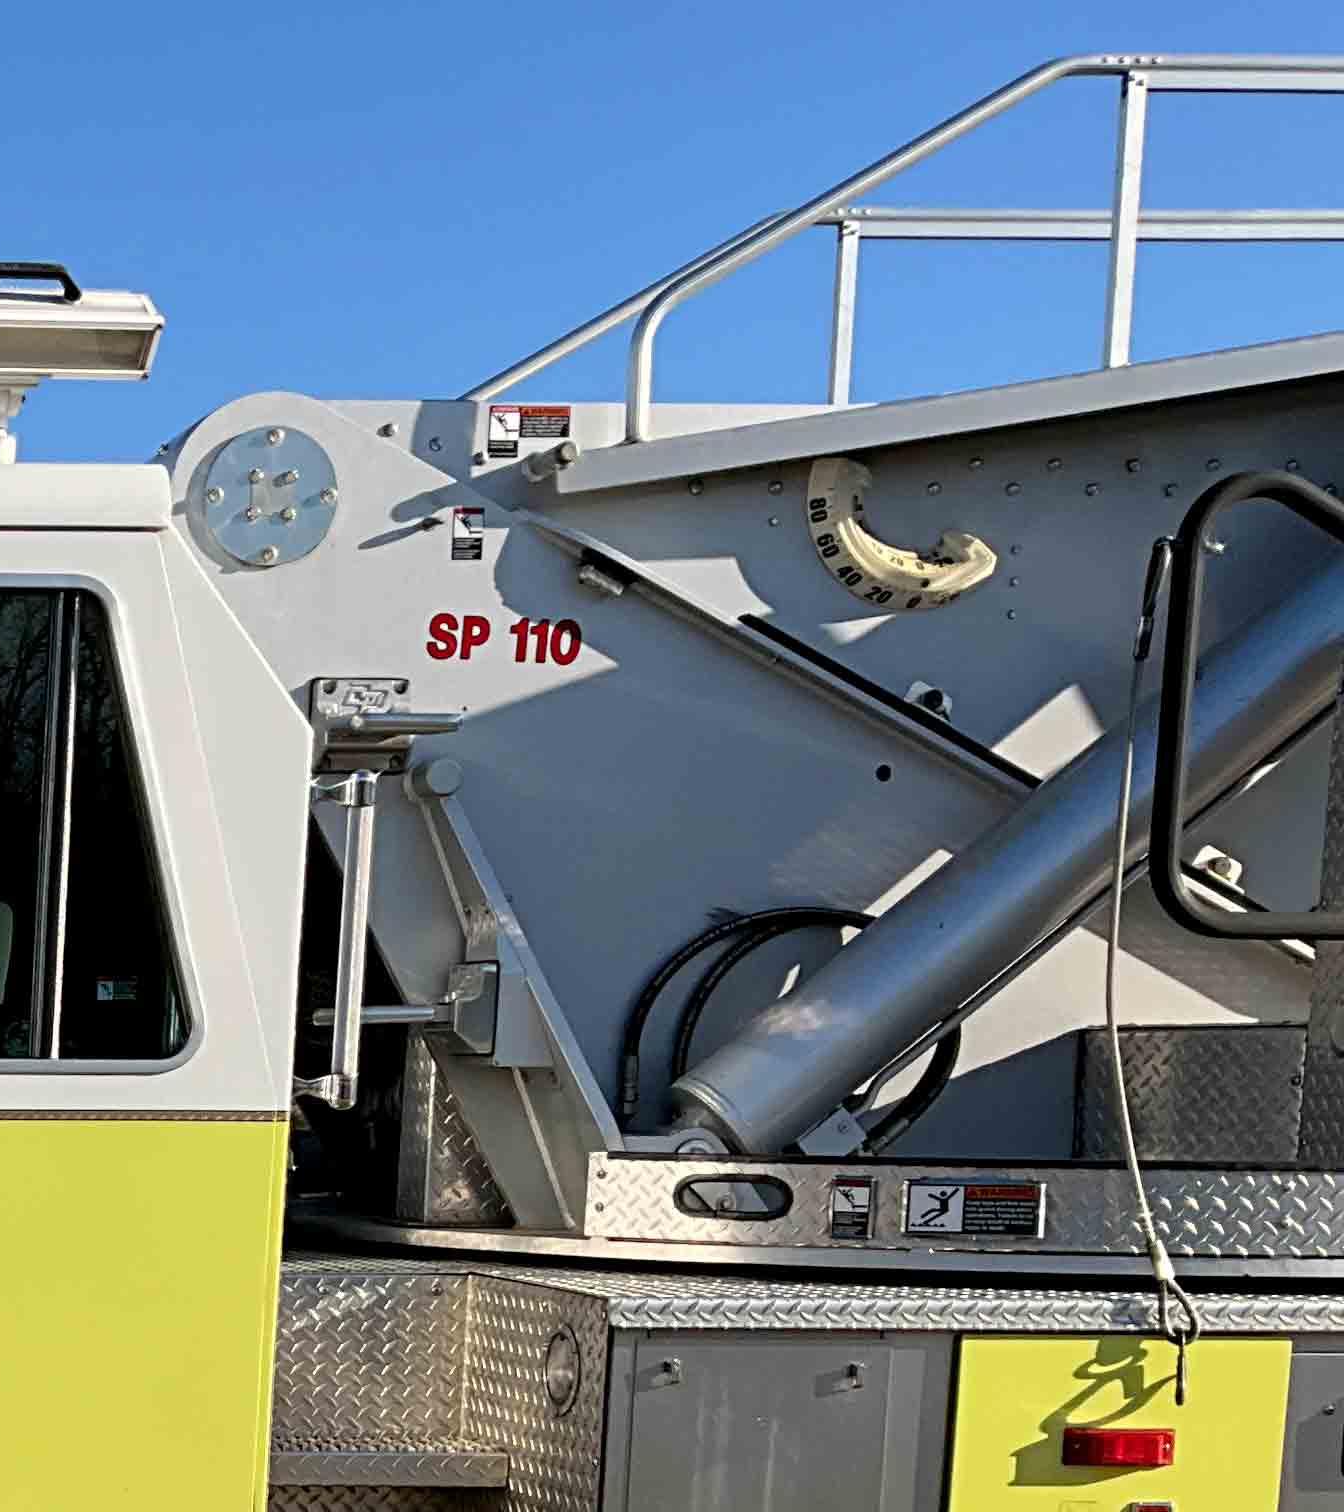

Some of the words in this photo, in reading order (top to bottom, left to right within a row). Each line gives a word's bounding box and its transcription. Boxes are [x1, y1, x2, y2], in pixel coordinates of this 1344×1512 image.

[809, 497, 828, 523] 80
[816, 533, 840, 559] 60
[837, 565, 863, 587] 40
[863, 585, 893, 604] 20
[426, 612, 491, 661] SP
[510, 618, 582, 666] 110
